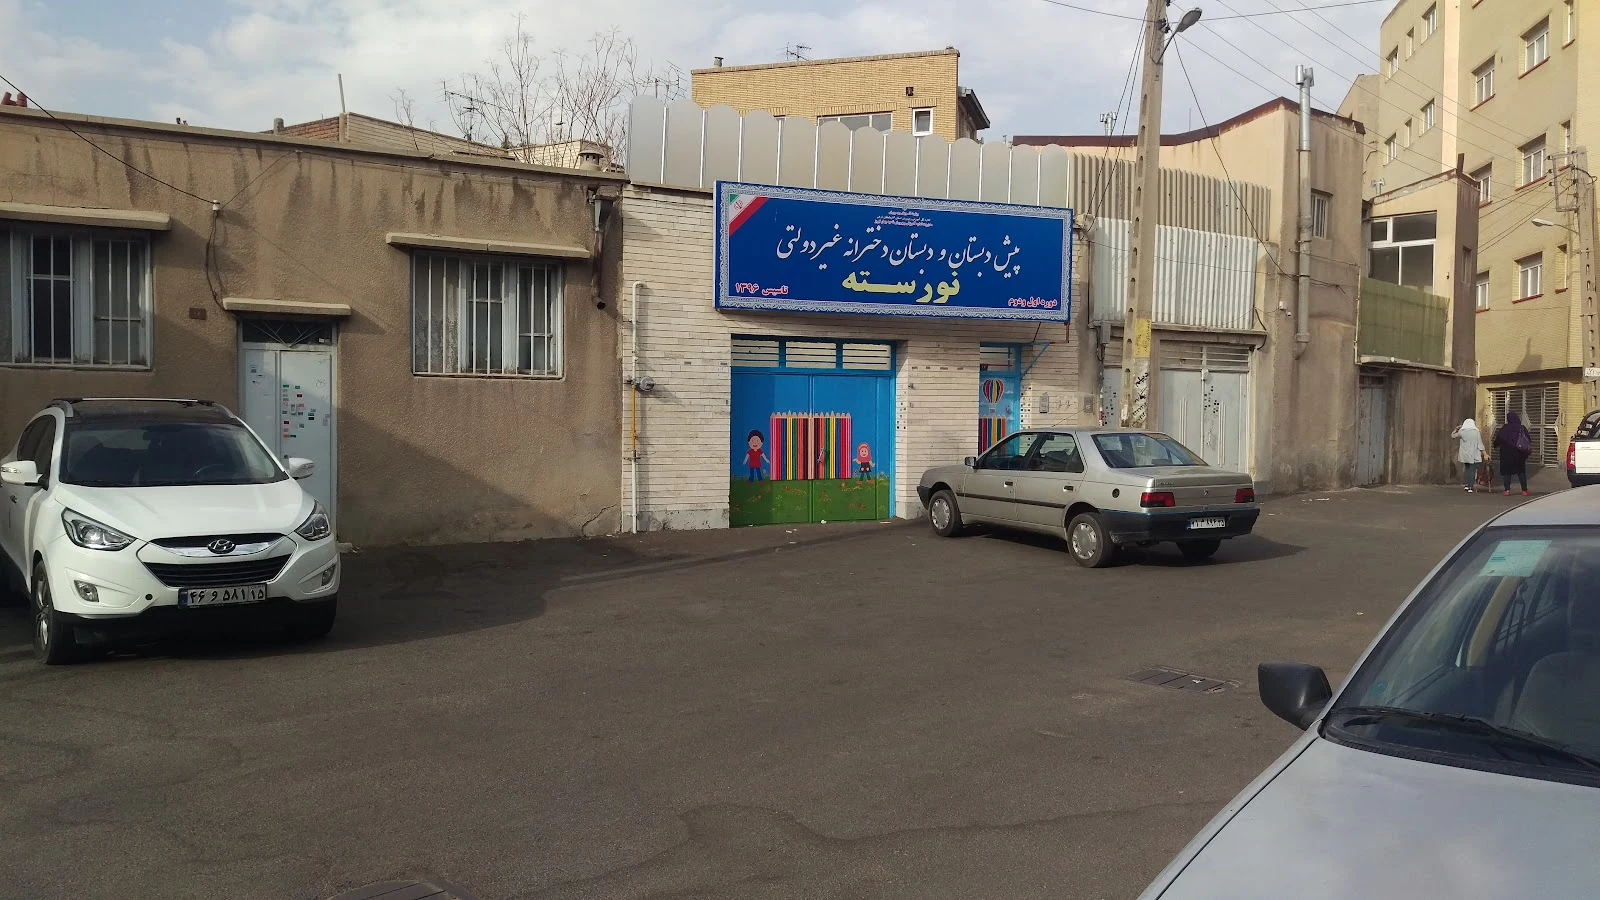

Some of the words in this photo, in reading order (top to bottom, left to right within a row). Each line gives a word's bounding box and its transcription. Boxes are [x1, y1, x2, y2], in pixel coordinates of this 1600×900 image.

[843, 225, 889, 263] دخترانه
[889, 232, 934, 275] دبستان
[938, 248, 947, 261] و
[948, 236, 992, 277] دبستان
[993, 235, 1020, 278] پیش
[735, 282, 759, 294] ۱۳۹۶
[762, 285, 788, 296] تاسیس
[1040, 299, 1057, 308] دوره
[223, 588, 246, 602] ۵۸۱
